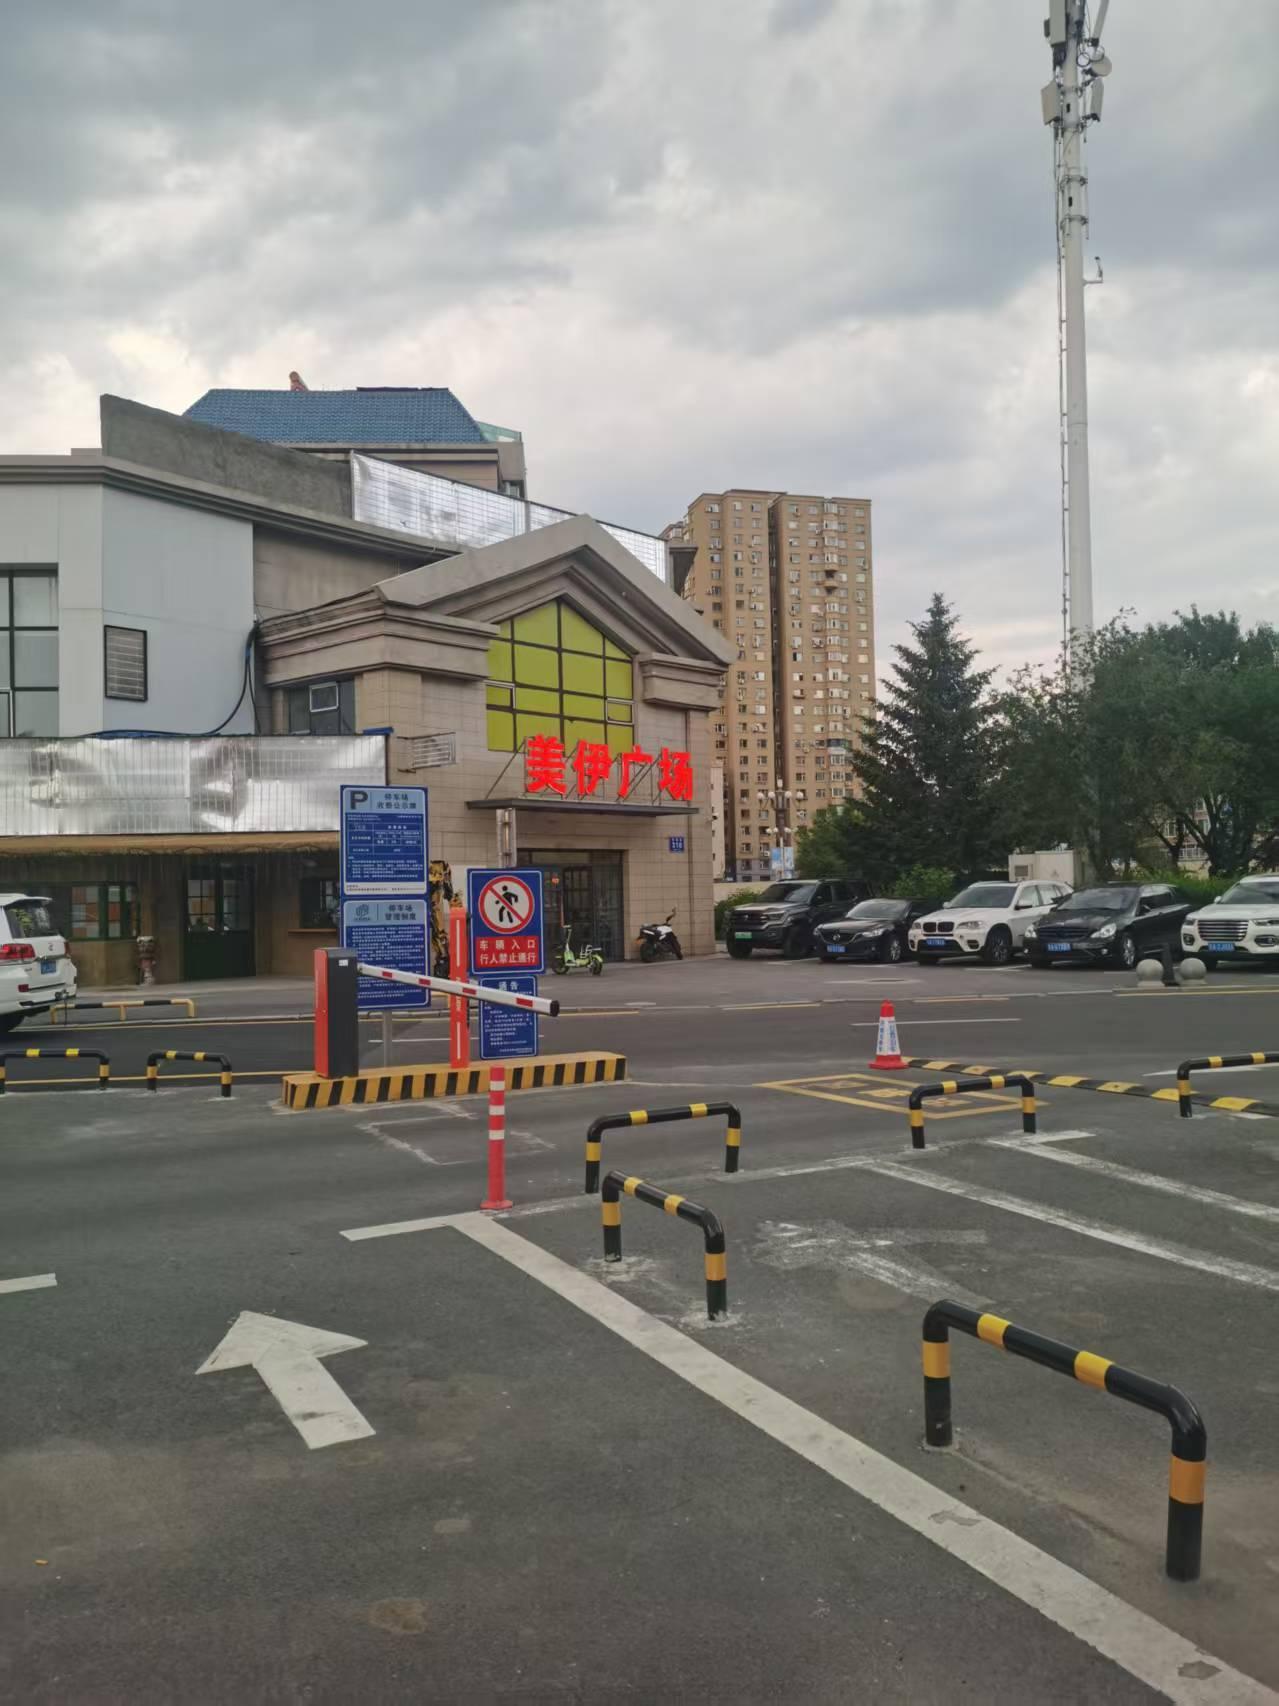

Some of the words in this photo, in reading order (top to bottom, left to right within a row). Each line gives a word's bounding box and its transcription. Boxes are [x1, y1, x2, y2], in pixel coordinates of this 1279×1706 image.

[527, 733, 693, 800] 美伊广场
[350, 790, 368, 810] P
[480, 939, 536, 952] 车辆入口
[480, 952, 536, 965] 行人禁止通行
